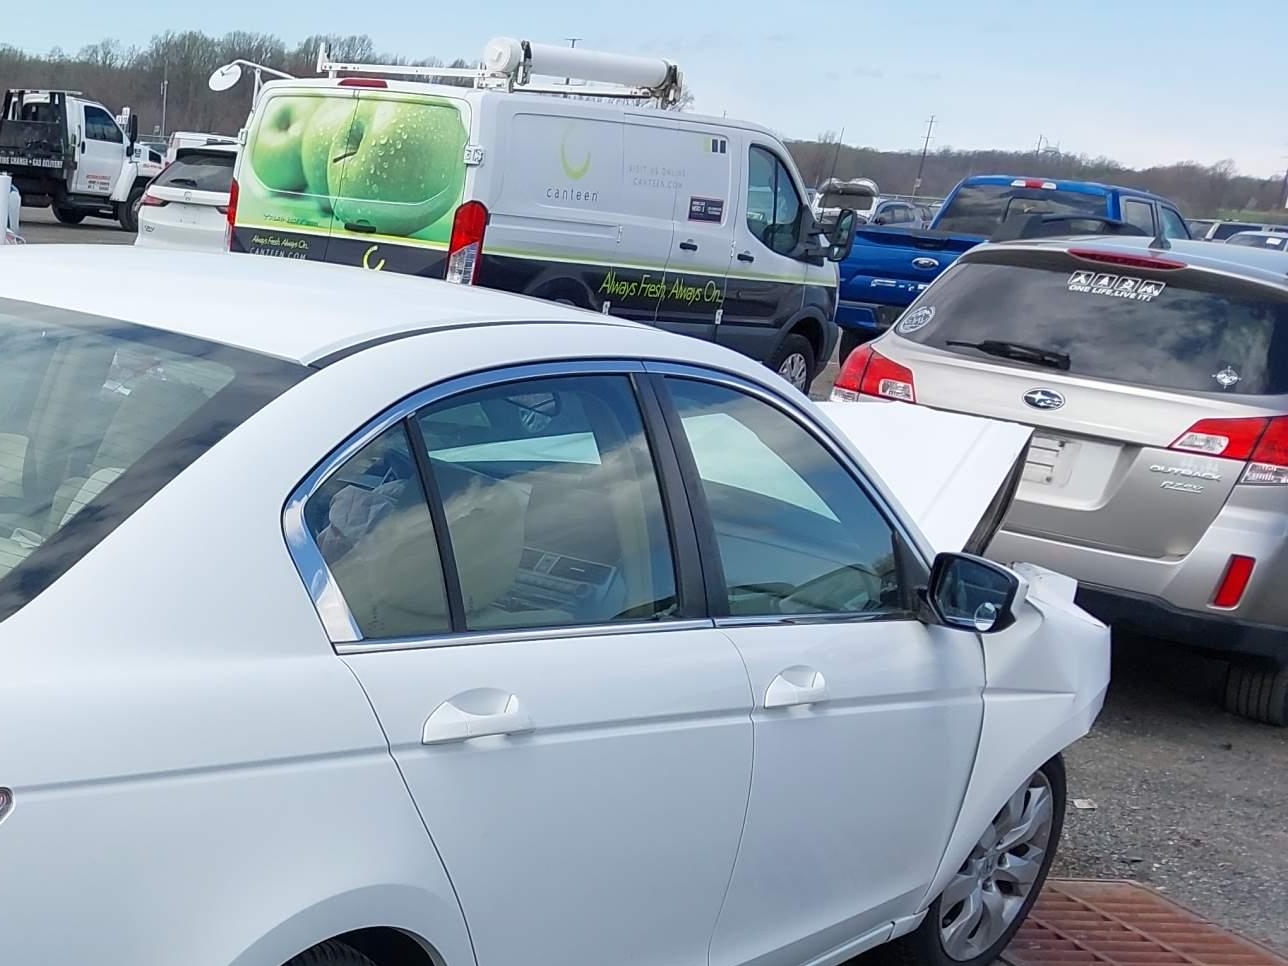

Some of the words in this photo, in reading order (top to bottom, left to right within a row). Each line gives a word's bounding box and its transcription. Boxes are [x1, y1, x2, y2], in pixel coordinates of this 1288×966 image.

[546, 187, 598, 202] canteen
[598, 271, 638, 301] Always
[668, 276, 703, 306] Always
[1068, 284, 1091, 293] ONE
[1149, 464, 1223, 482] OUTBACK
